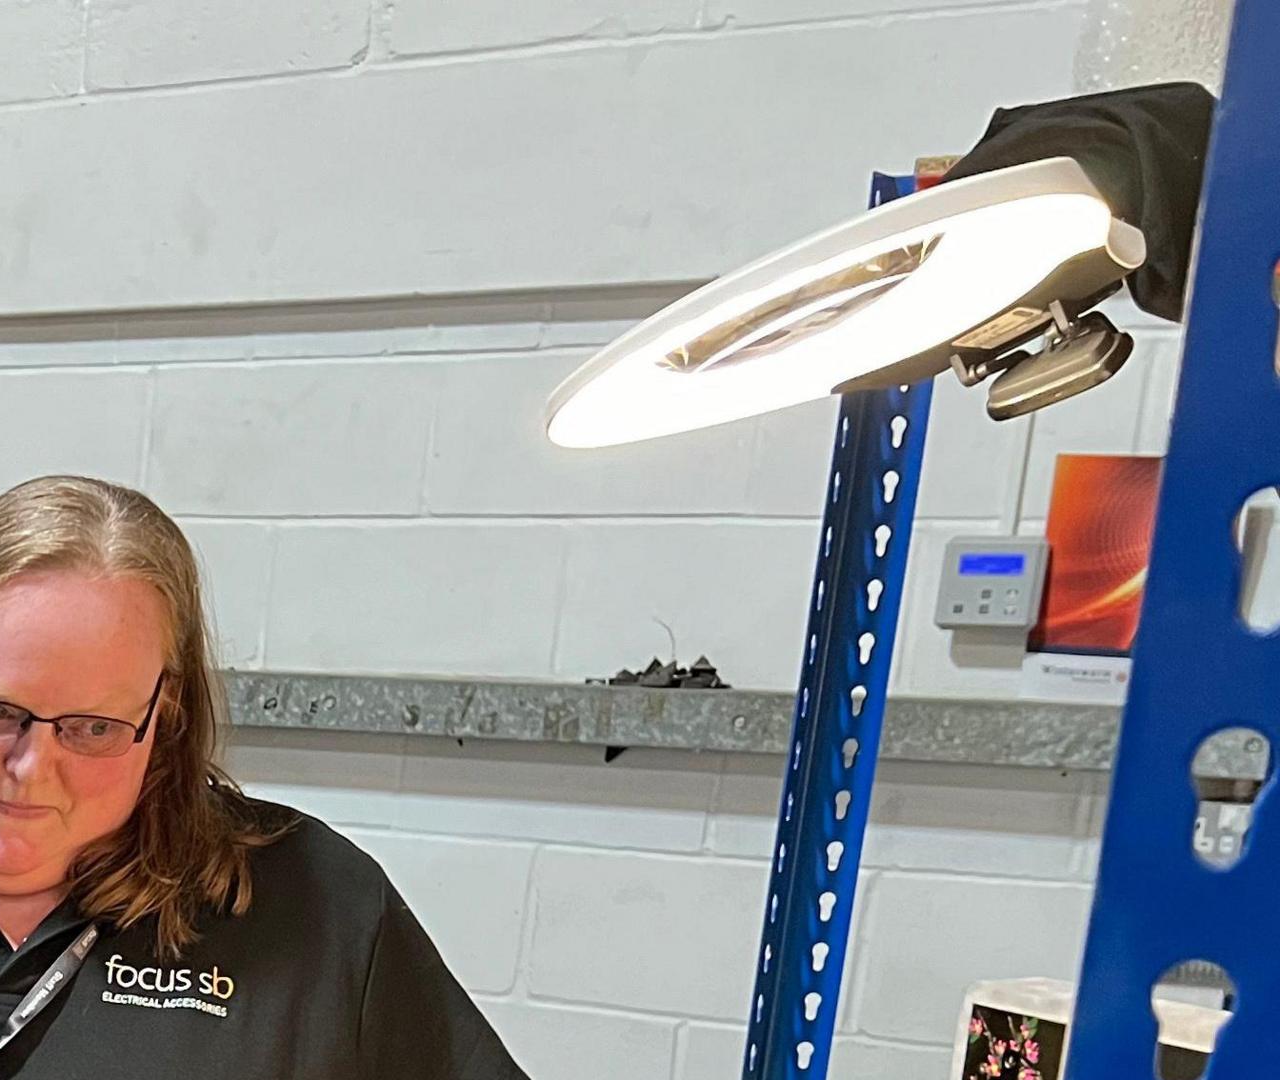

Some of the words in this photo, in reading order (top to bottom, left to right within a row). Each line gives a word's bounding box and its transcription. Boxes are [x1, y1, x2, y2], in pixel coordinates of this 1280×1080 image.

[105, 954, 192, 992] focus
[198, 966, 234, 999] sb
[102, 991, 162, 1009] ELECTRICAL
[163, 998, 228, 1017] ACCESSORIES
